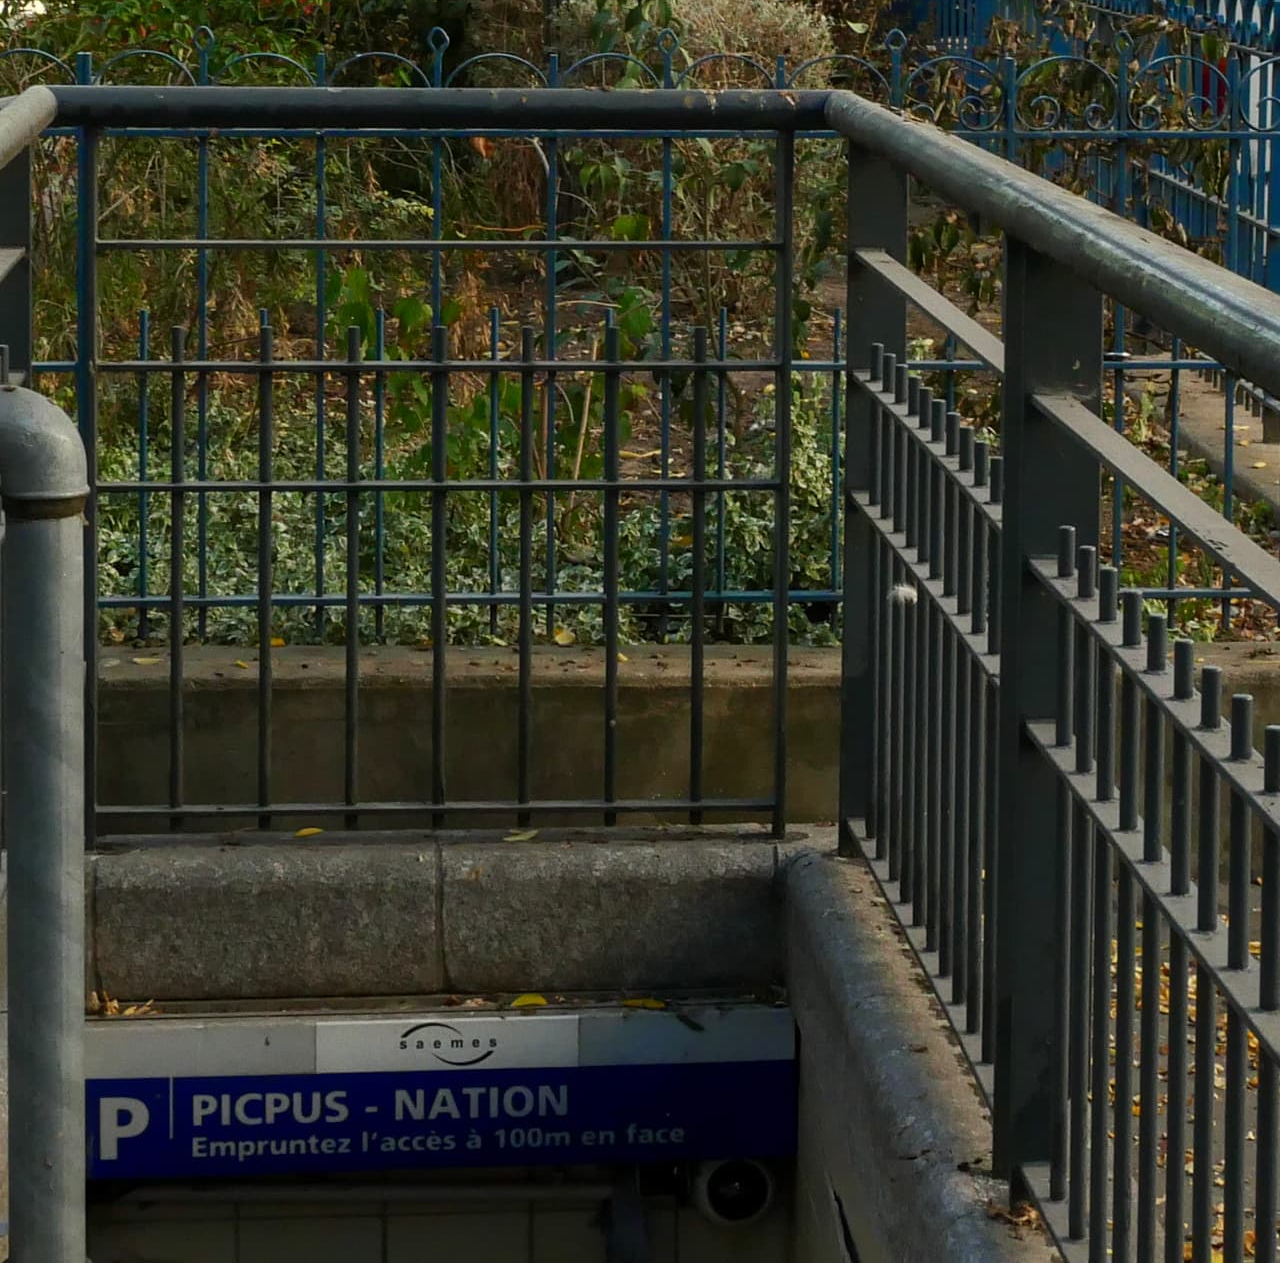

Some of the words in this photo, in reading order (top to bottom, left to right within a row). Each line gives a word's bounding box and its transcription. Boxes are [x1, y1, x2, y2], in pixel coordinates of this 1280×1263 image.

[399, 1038, 498, 1050] saemes
[192, 1091, 349, 1126] PICPUS
[394, 1085, 568, 1121] NATION
[99, 1097, 150, 1161] P
[191, 1134, 351, 1162] Empruntez
[362, 1129, 456, 1153] l'accès
[465, 1129, 482, 1150] à
[494, 1127, 571, 1149] 100m
[580, 1129, 615, 1146] en
[625, 1122, 686, 1145] face
